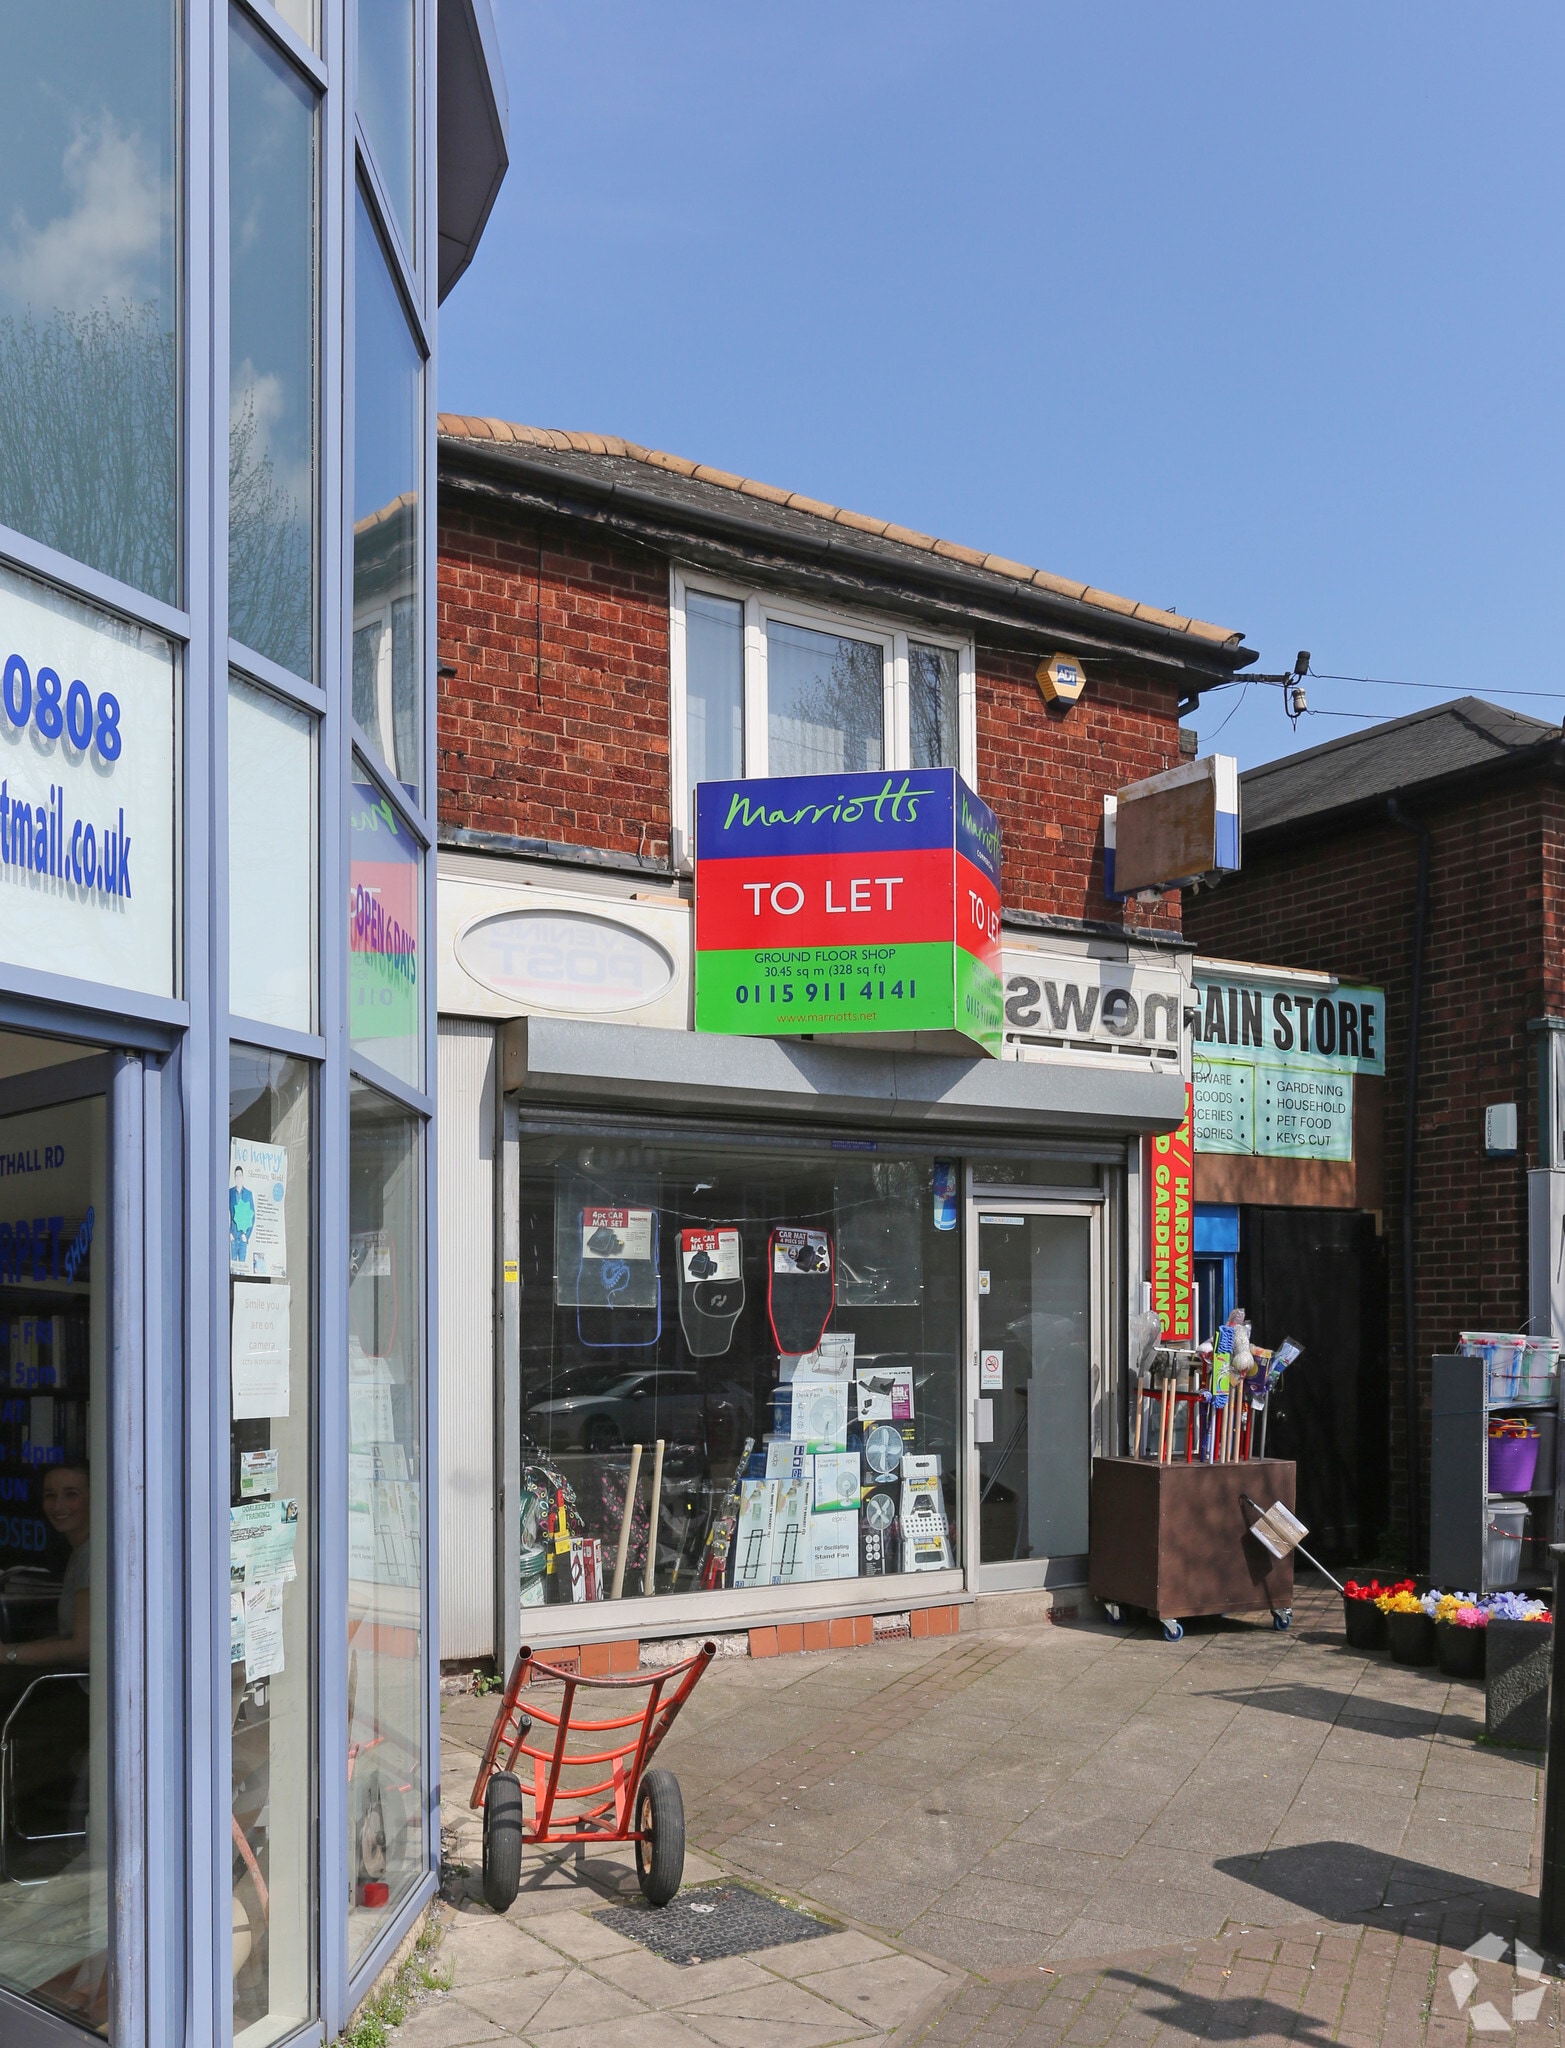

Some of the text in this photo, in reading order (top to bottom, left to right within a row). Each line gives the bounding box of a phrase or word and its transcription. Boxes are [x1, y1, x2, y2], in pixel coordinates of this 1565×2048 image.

[1057, 668, 1077, 682] ADT
[3, 654, 122, 762] 0808
[0, 778, 131, 898] tmail.co.uk
[743, 877, 904, 916] TO LET
[968, 889, 1000, 946] TO LET
[356, 883, 416, 986] OPEN 6 DAYS
[753, 948, 896, 964] GROUND FLOOR SHOP
[764, 963, 886, 979] 30.45 sq m (328 sq ft)
[735, 979, 916, 1004] 0115 911 4141
[776, 1011, 878, 1024] www.marriotts.net
[1272, 992, 1376, 1059] STORE
[1276, 1080, 1343, 1097] GARDENING
[1195, 1090, 1233, 1104] GOODS
[1277, 1099, 1346, 1114] HOUSEHOLD
[1276, 1115, 1332, 1130] PET FOOD
[1276, 1132, 1332, 1146] KEYS CUT
[44, 1145, 65, 1169] RD
[592, 1211, 606, 1219] 4pc
[608, 1211, 624, 1219] CAR
[592, 1219, 608, 1227] MAT
[611, 1219, 624, 1227] SET
[778, 1230, 792, 1239] CAR
[793, 1231, 807, 1240] MAT
[65, 1205, 95, 1287] SHOP
[691, 1242, 716, 1251] MAT SET
[1155, 1164, 1170, 1335] GARDENING
[1174, 1177, 1190, 1336] HARDWARE
[244, 1298, 280, 1313] Smile you
[24, 1322, 54, 1345] FRI
[250, 1321, 274, 1330] are on
[248, 1340, 276, 1350] camera
[15, 1361, 57, 1391] 5pm
[21, 1440, 65, 1470] 4pm
[242, 1502, 276, 1513] GOALKEEPER
[245, 1511, 271, 1521] TRAINING
